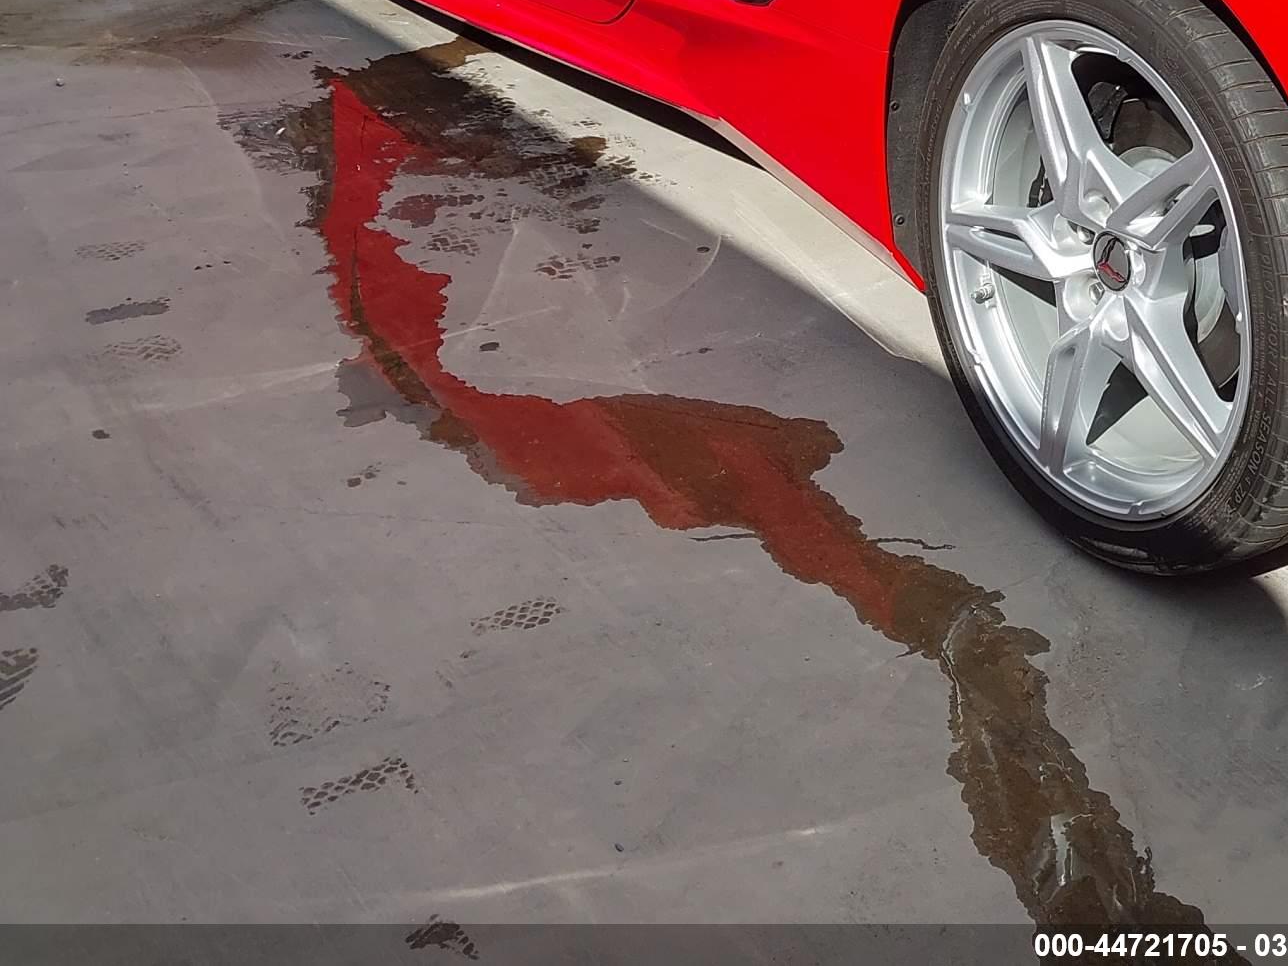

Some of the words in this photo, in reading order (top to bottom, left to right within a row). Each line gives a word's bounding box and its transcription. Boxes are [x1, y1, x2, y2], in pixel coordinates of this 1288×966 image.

[1266, 310, 1281, 371] SPORT
[1262, 372, 1280, 413] ALL
[1246, 411, 1273, 476] SEASON
